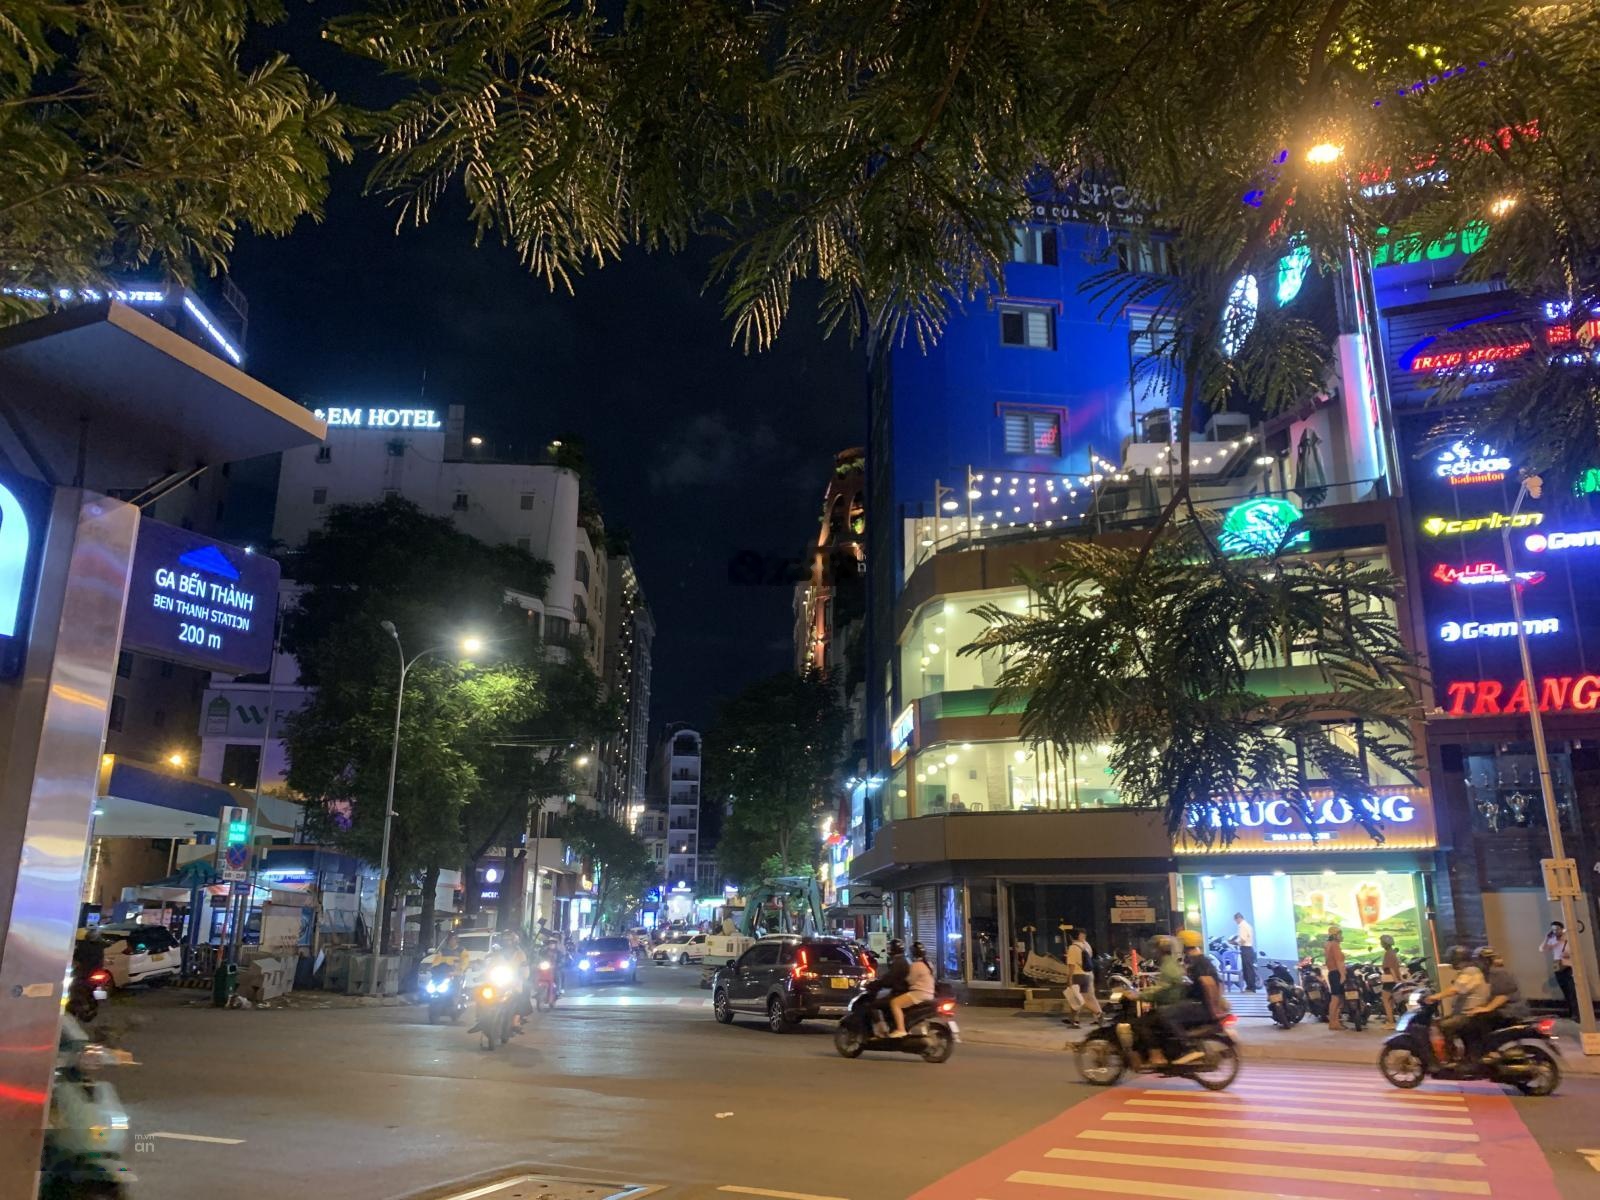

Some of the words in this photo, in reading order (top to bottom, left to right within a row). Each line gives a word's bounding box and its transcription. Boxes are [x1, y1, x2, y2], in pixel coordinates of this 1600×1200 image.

[367, 408, 441, 427] HOTEL
[1450, 472, 1505, 485] badminton
[1445, 512, 1544, 533] carlton
[155, 568, 176, 590] GA
[210, 583, 254, 612] THÀNH
[153, 593, 174, 612] BEN
[176, 599, 209, 620] THANH
[211, 609, 250, 631] STATION
[178, 622, 205, 645] 200
[208, 633, 221, 649] m
[1448, 675, 1600, 717] TRANG
